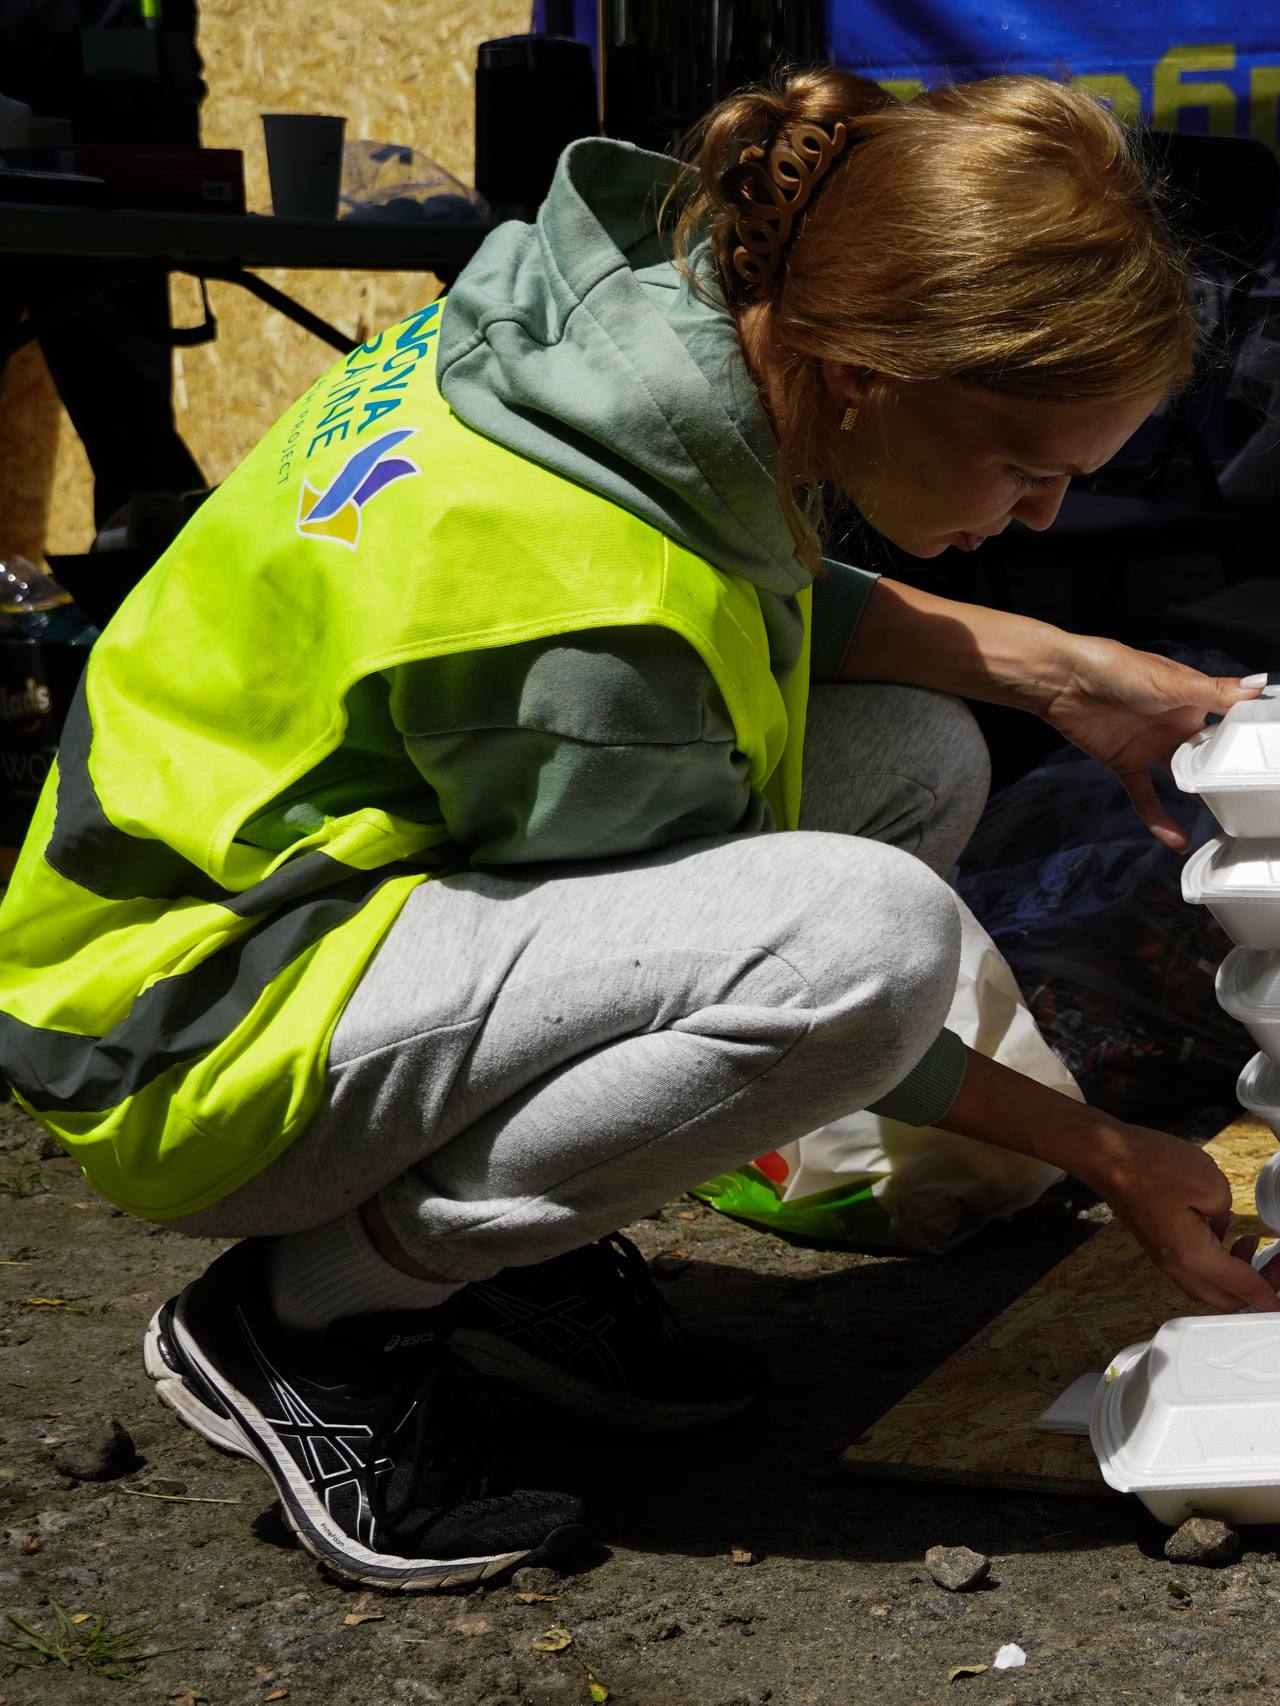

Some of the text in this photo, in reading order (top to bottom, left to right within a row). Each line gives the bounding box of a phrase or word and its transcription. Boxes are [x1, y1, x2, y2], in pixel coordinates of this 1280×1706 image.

[305, 331, 385, 459] RAINE
[357, 302, 440, 436] NOVA
[0, 752, 50, 784] WO
